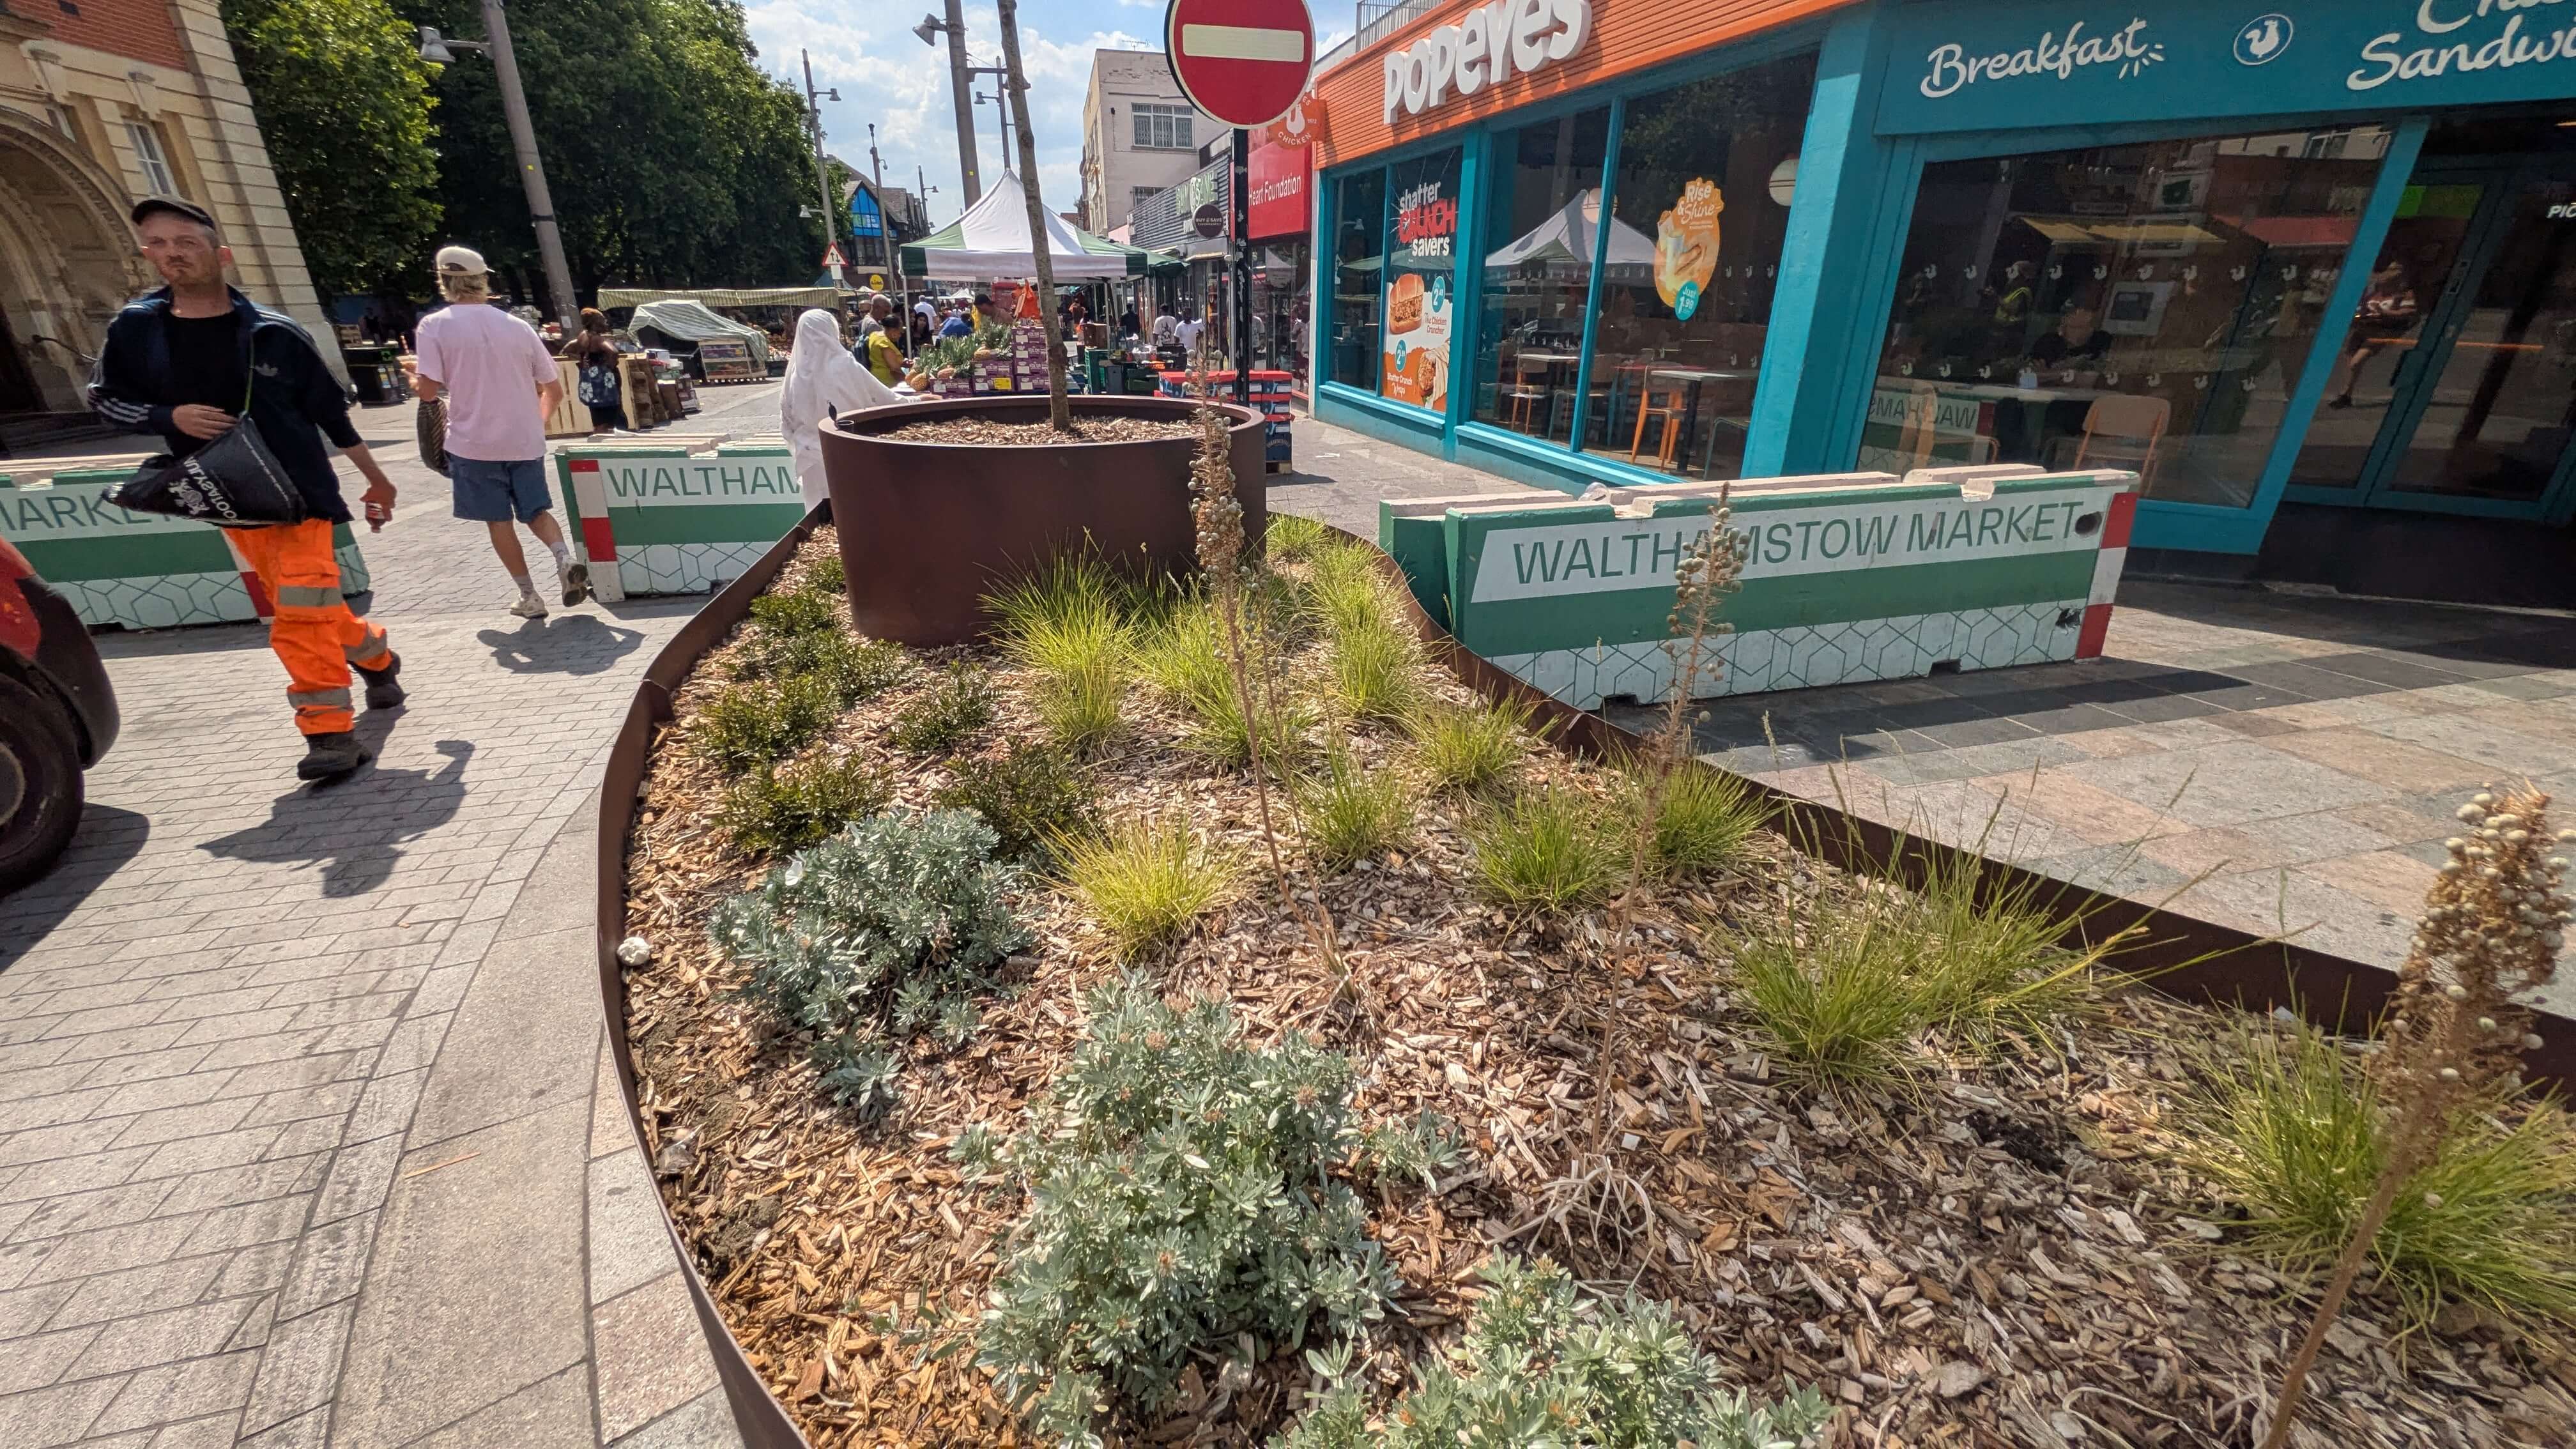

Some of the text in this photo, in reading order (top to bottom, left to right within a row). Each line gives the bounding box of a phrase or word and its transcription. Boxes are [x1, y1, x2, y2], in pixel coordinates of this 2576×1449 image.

[1920, 17, 2148, 98] Breakfast
[1278, 131, 1312, 146] CHICKEN
[1248, 172, 1301, 206] Heart Foundation
[1399, 181, 1441, 214] shatter
[1687, 183, 1712, 203] Rise
[1399, 197, 1457, 244] CRUNCH
[1677, 201, 1715, 225] & Shine
[1412, 236, 1450, 257] savers
[1513, 501, 2084, 584] WALTHAMSTOW MARKET
